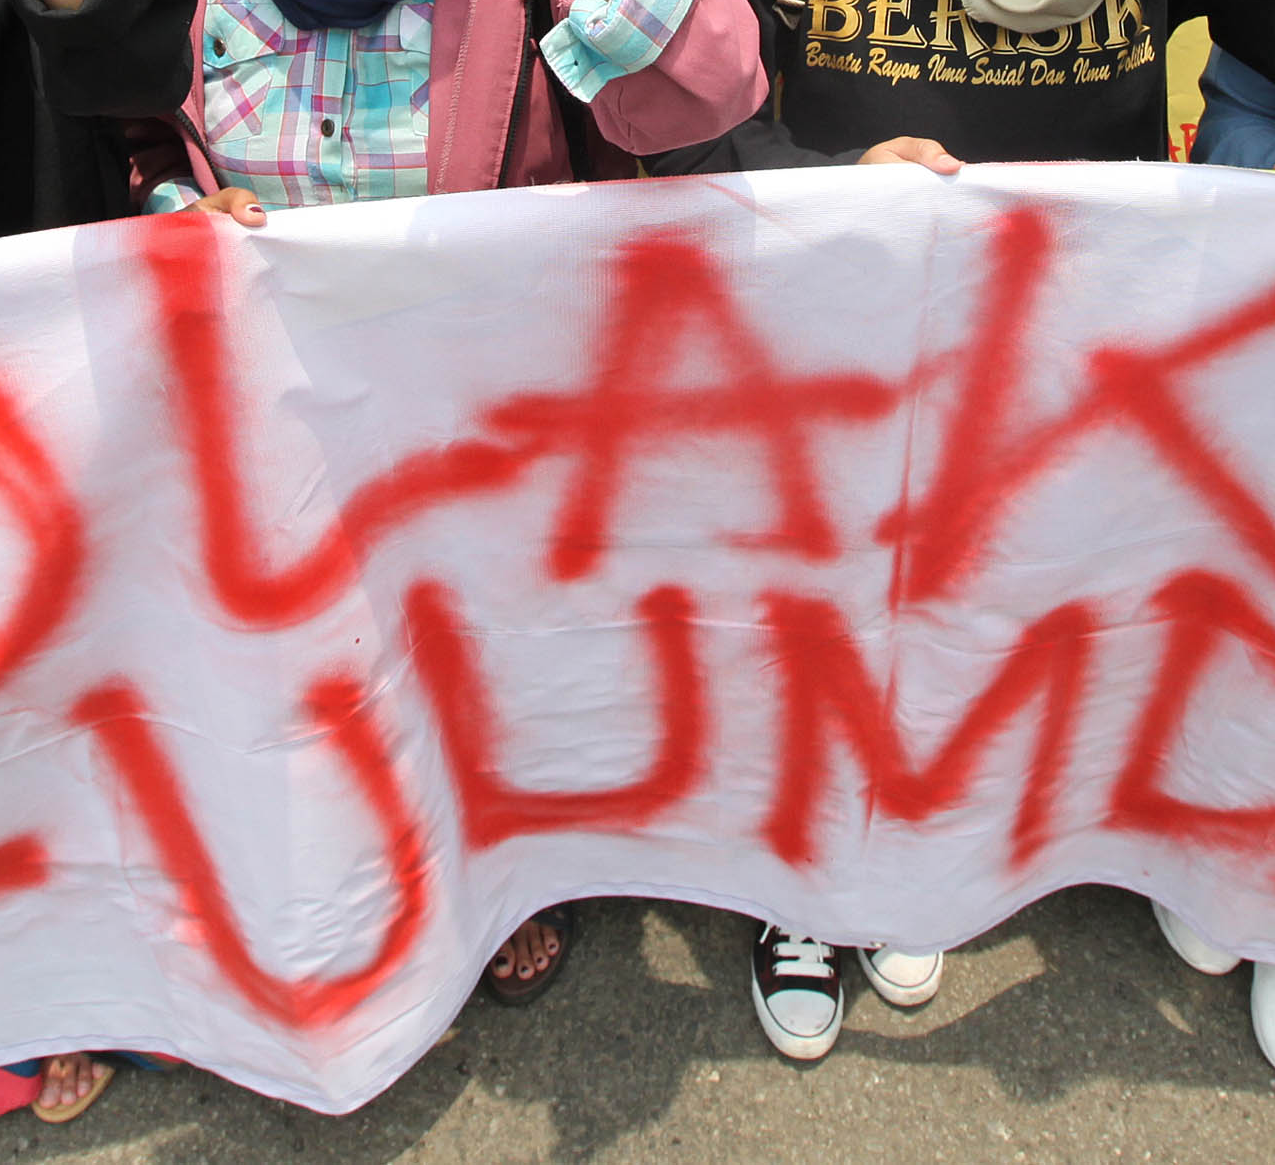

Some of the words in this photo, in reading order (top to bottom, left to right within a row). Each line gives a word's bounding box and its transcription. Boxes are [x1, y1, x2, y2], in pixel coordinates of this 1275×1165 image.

[805, 41, 862, 75] Bersatu
[867, 47, 921, 86] Rayon
[927, 53, 967, 84] Ilmu
[971, 56, 1026, 86] Sosial
[1030, 58, 1067, 86] Dan
[1073, 57, 1112, 84] Ilmu
[1116, 34, 1156, 80] Politik
